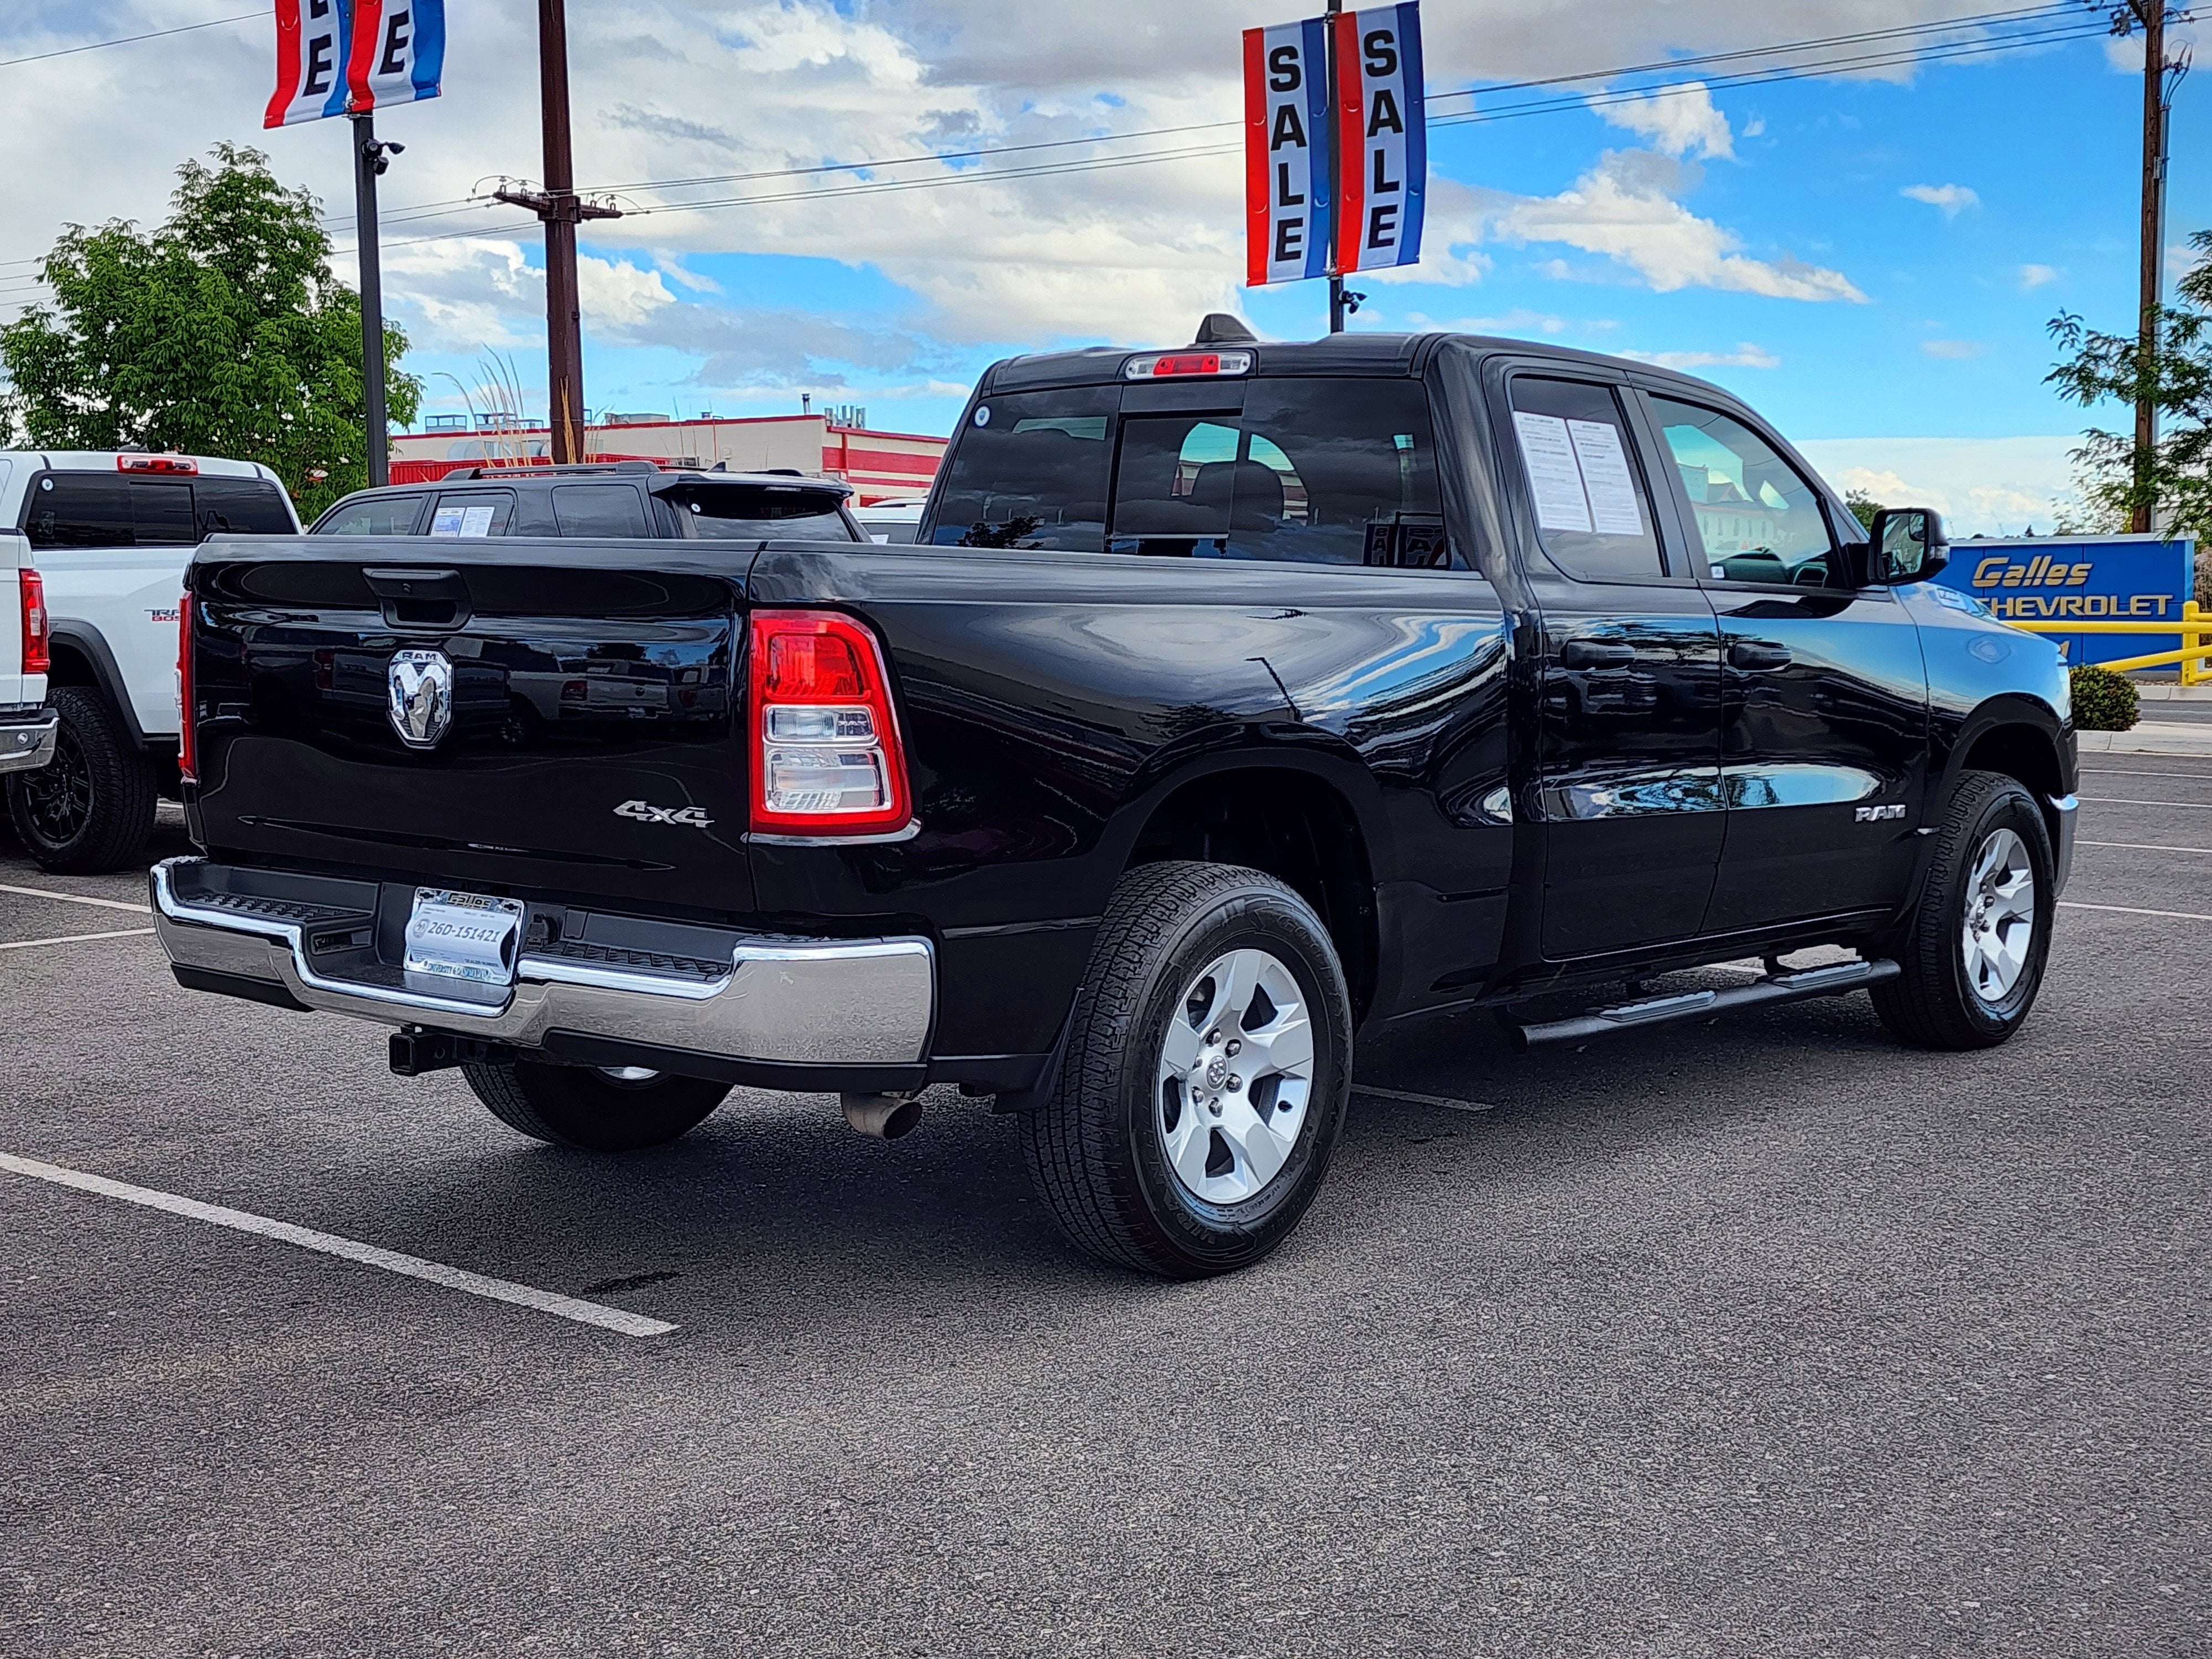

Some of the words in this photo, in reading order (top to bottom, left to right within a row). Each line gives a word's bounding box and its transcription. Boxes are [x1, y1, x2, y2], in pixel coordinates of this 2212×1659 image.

[1362, 29, 1404, 249] SALE
[1268, 46, 1308, 263] SALE
[1972, 555, 2093, 587] Galles
[1978, 594, 2173, 617] HEVROLET
[402, 652, 437, 661] RAM
[1855, 804, 1906, 822] RAM
[446, 893, 491, 909] Galles
[427, 922, 501, 943] 26D-151421
